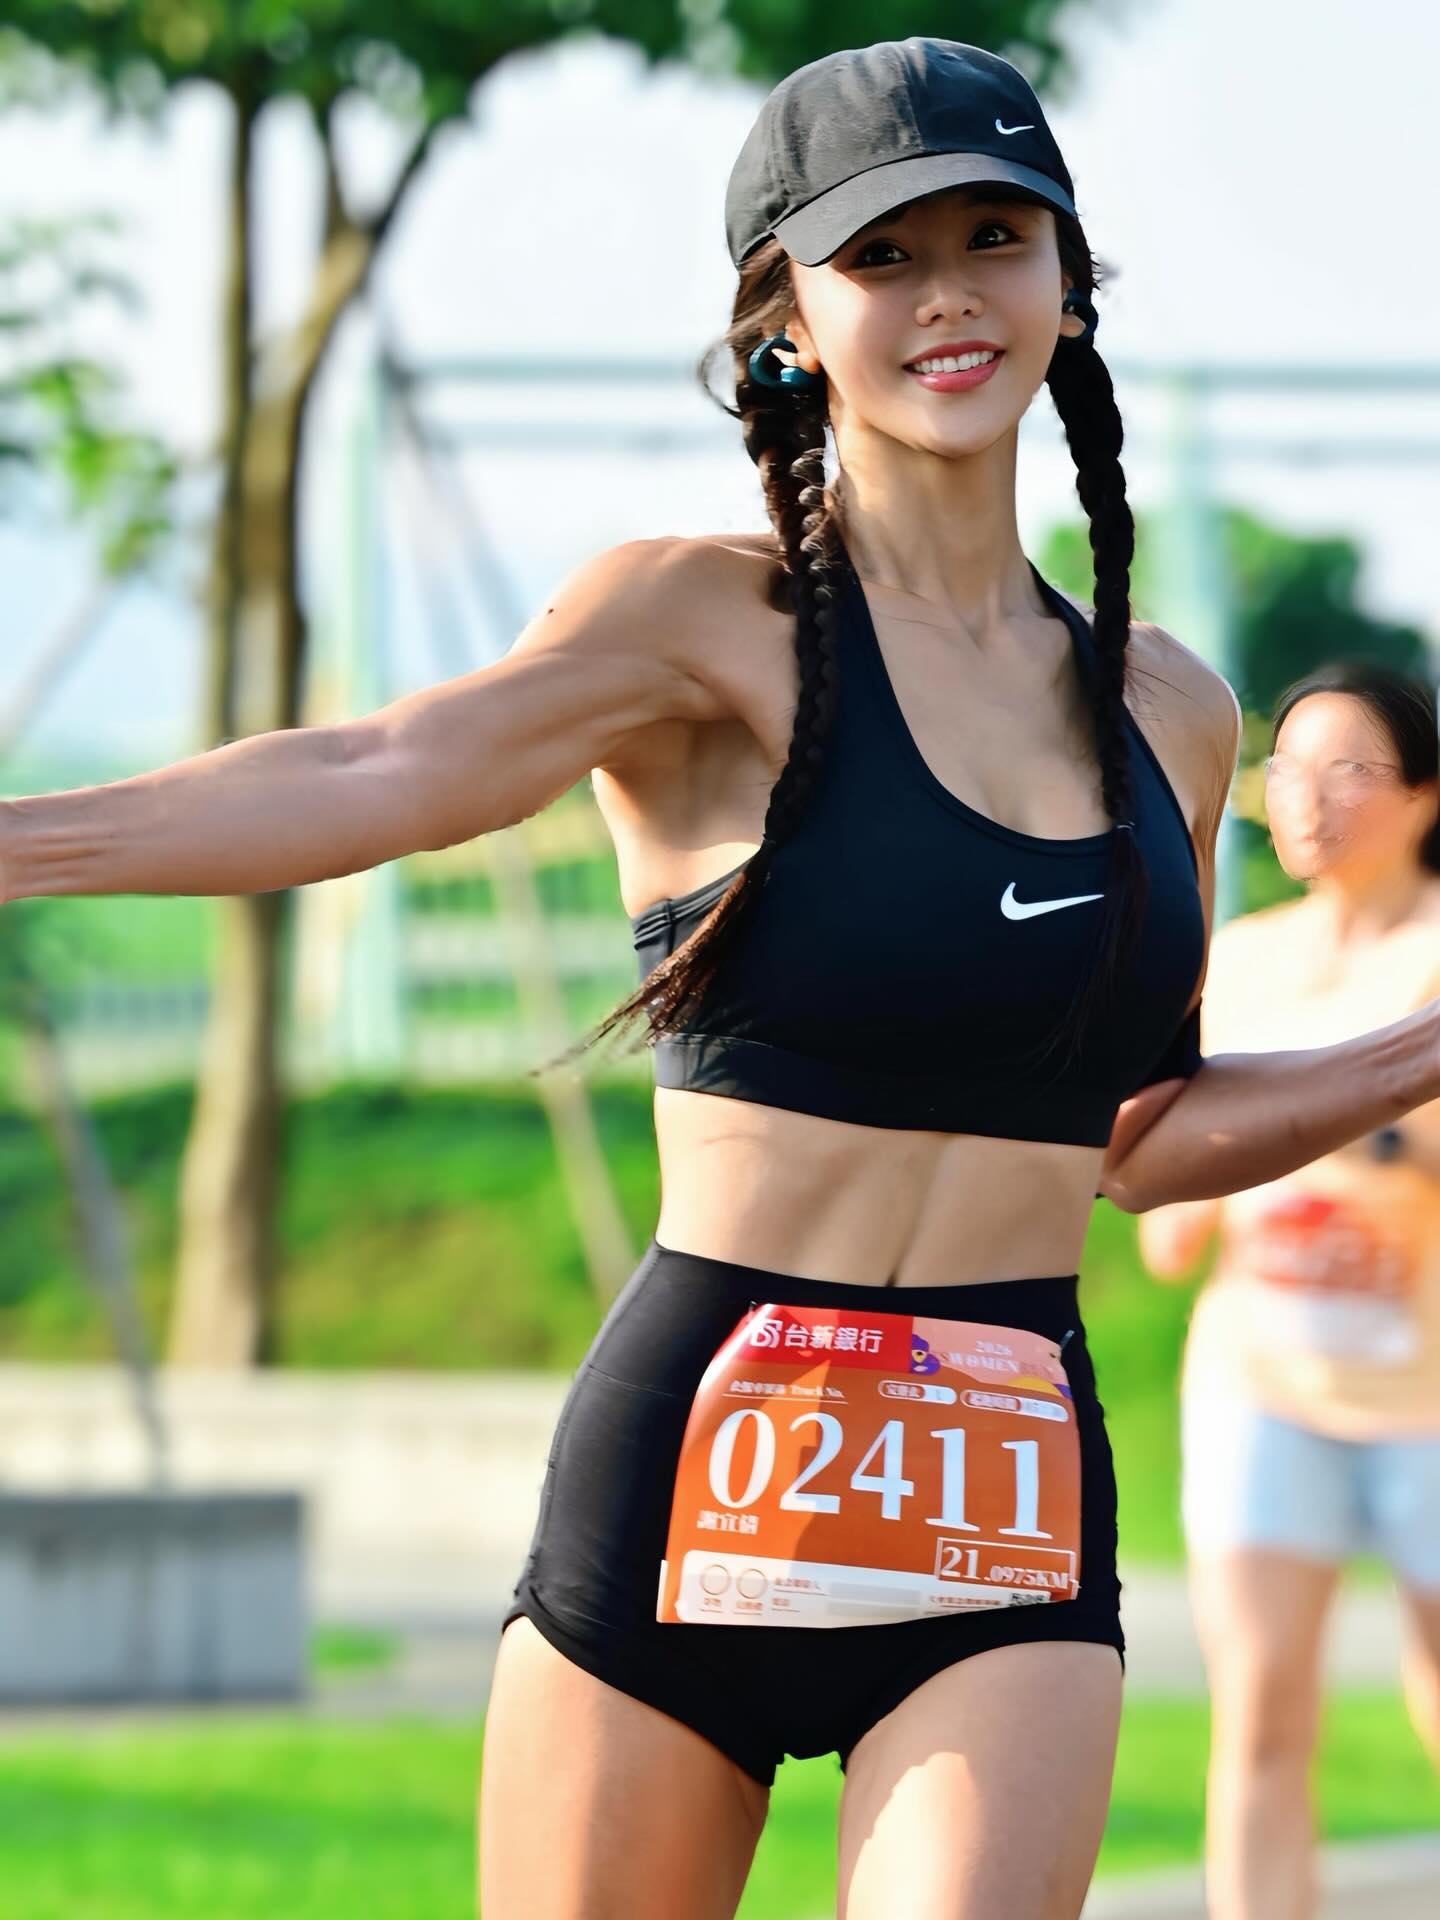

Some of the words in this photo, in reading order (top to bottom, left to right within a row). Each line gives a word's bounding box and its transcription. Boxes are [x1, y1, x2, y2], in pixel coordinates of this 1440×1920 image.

[784, 1324, 883, 1352] 台新銀行
[708, 1408, 1053, 1540] 02411
[940, 1545, 1070, 1589] 21.0975KM
